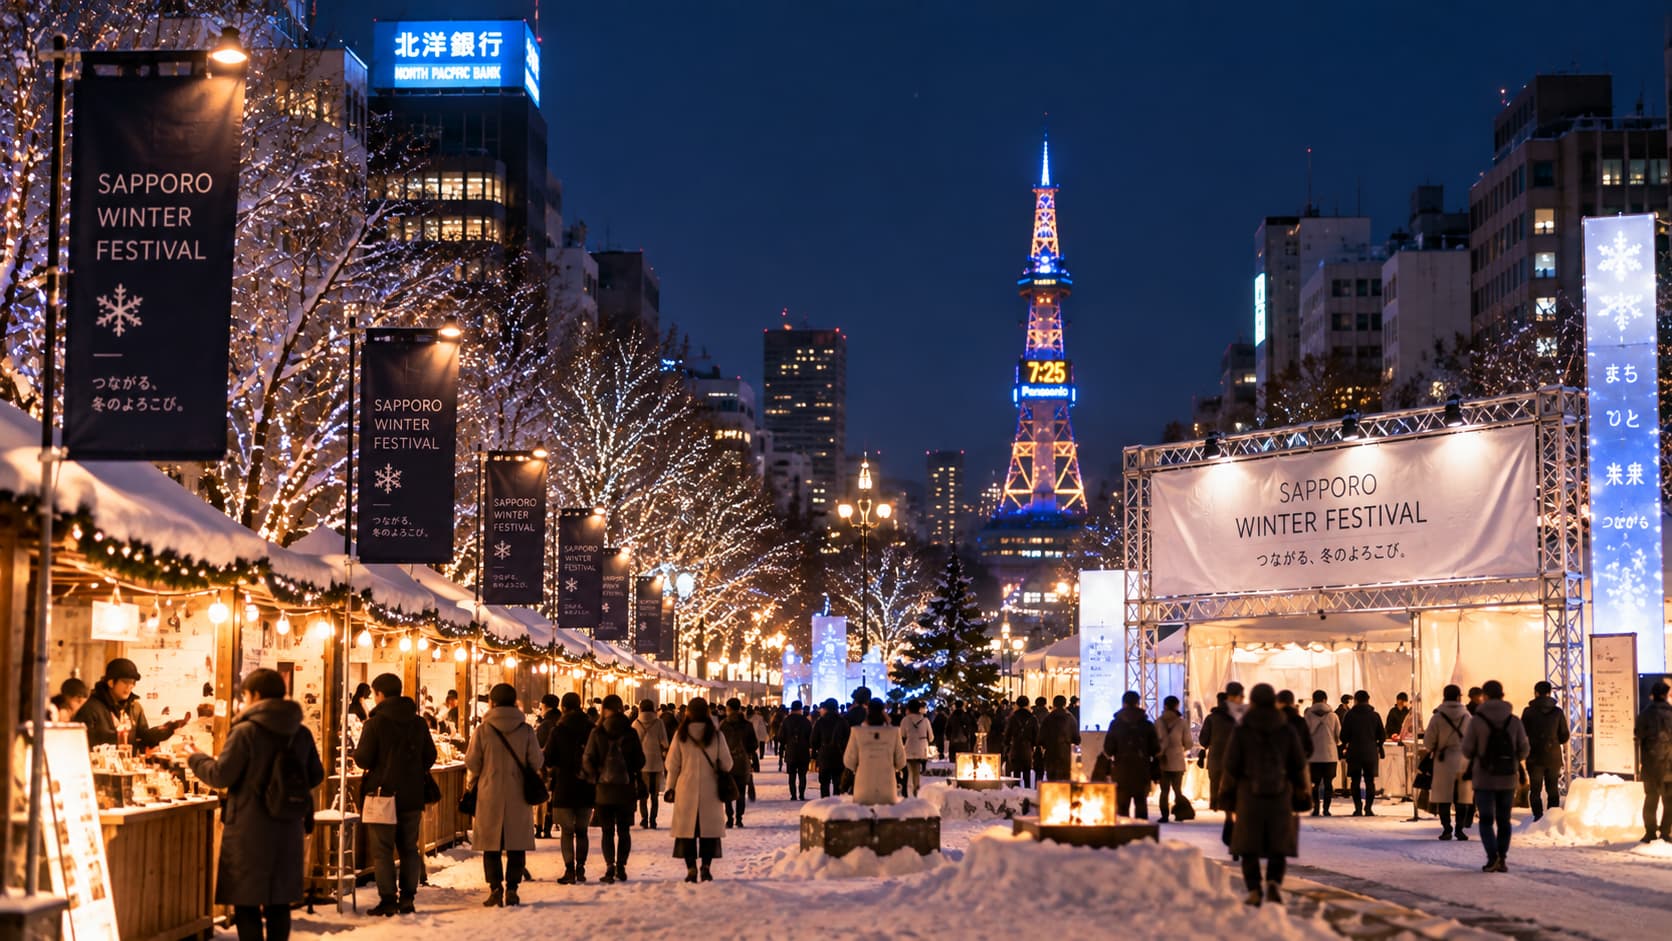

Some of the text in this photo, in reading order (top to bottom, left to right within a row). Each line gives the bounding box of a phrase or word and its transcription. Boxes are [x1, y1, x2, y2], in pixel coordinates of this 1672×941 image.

[395, 31, 503, 57] 北洋銀行
[98, 172, 213, 194] SAPPORO
[97, 206, 192, 228] WINTER
[96, 239, 207, 261] FESTIVAL
[1027, 361, 1066, 383] 7:25
[1605, 363, 1638, 383] まち
[92, 375, 157, 391] つながる、
[91, 396, 183, 412] 冬のよろこび。
[374, 399, 443, 412] SAPPORO
[374, 418, 430, 431] WINTER
[1606, 409, 1639, 428] ひと
[374, 437, 440, 450] FESTIVAL
[1279, 473, 1377, 504] SAPPORO
[494, 498, 537, 507] SAPPORO
[494, 511, 529, 519] WINTER
[1236, 501, 1428, 539] WINTER FESTIVAL
[494, 523, 536, 532] FESTIVAL
[1256, 543, 1405, 567] つながる、冬のよろこび。
